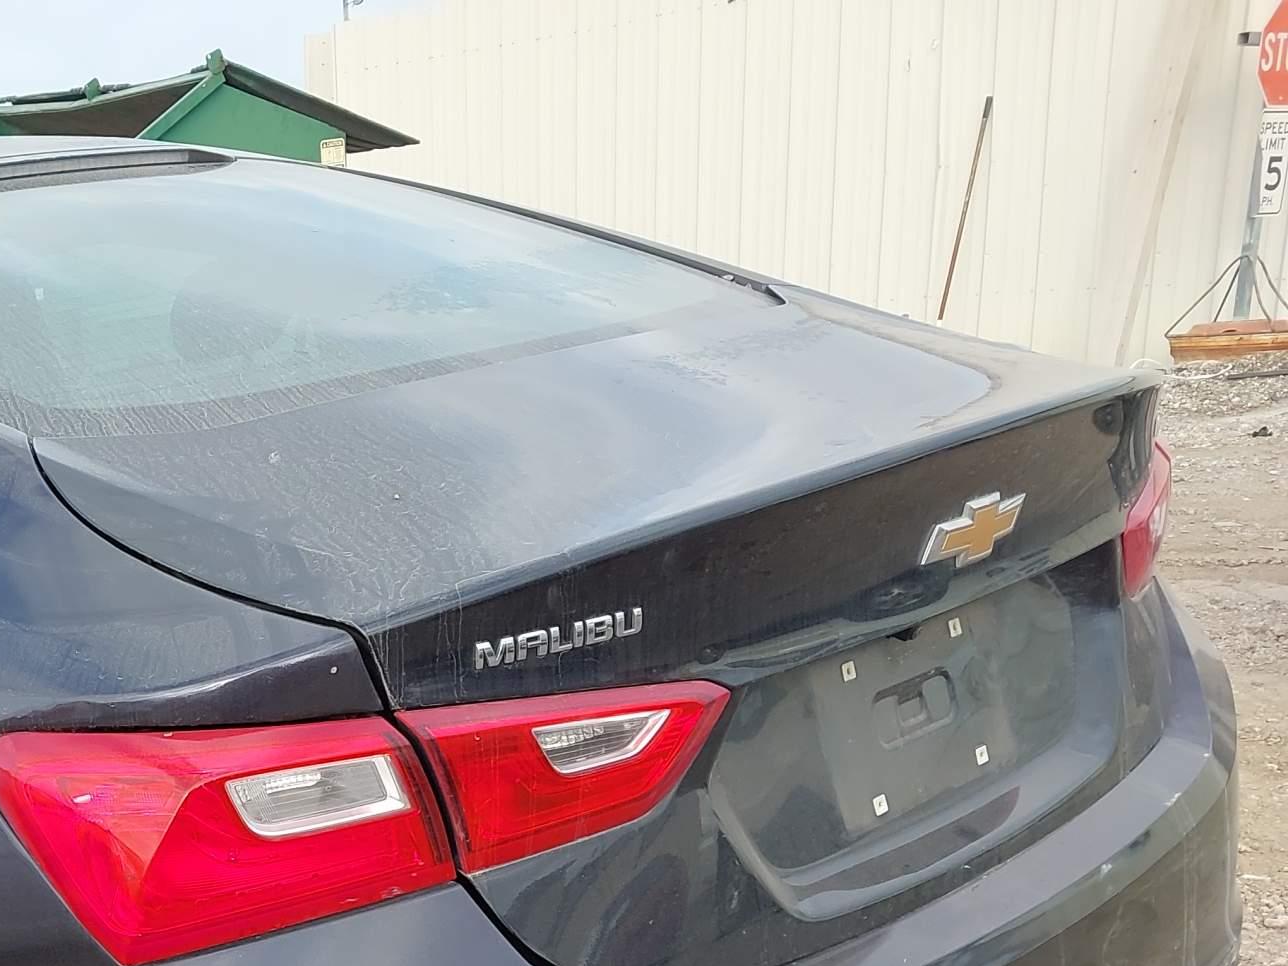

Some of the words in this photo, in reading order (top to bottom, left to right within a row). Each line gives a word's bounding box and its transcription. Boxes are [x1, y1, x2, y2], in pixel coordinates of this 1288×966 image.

[1261, 32, 1288, 71] ST
[1264, 156, 1282, 191] 5
[474, 607, 643, 670] MALIBU
